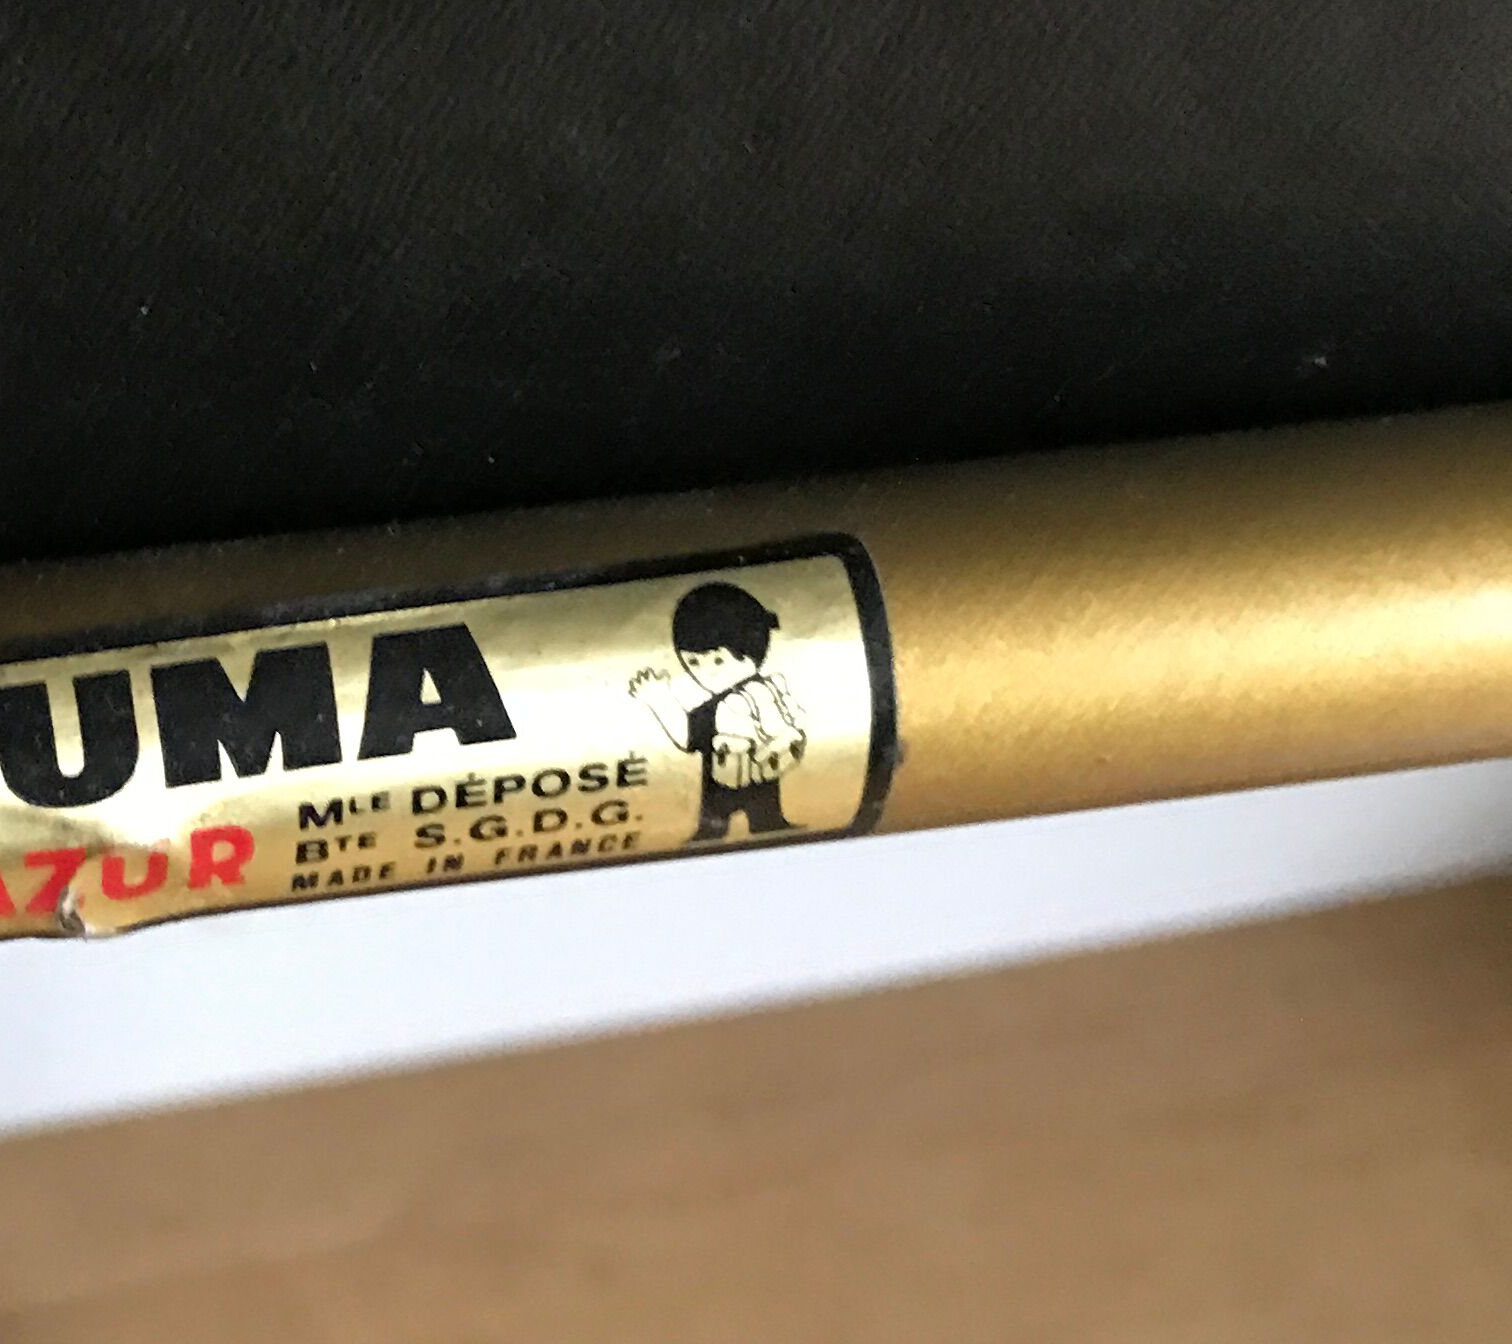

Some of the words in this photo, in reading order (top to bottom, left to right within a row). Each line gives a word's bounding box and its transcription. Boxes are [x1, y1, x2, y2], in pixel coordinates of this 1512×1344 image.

[410, 751, 648, 815] DÉPOSÉ
[413, 799, 643, 849] S.G.D.G.
[291, 861, 397, 893] MADE
[426, 854, 465, 874] IN
[494, 831, 641, 866] FRANCE
